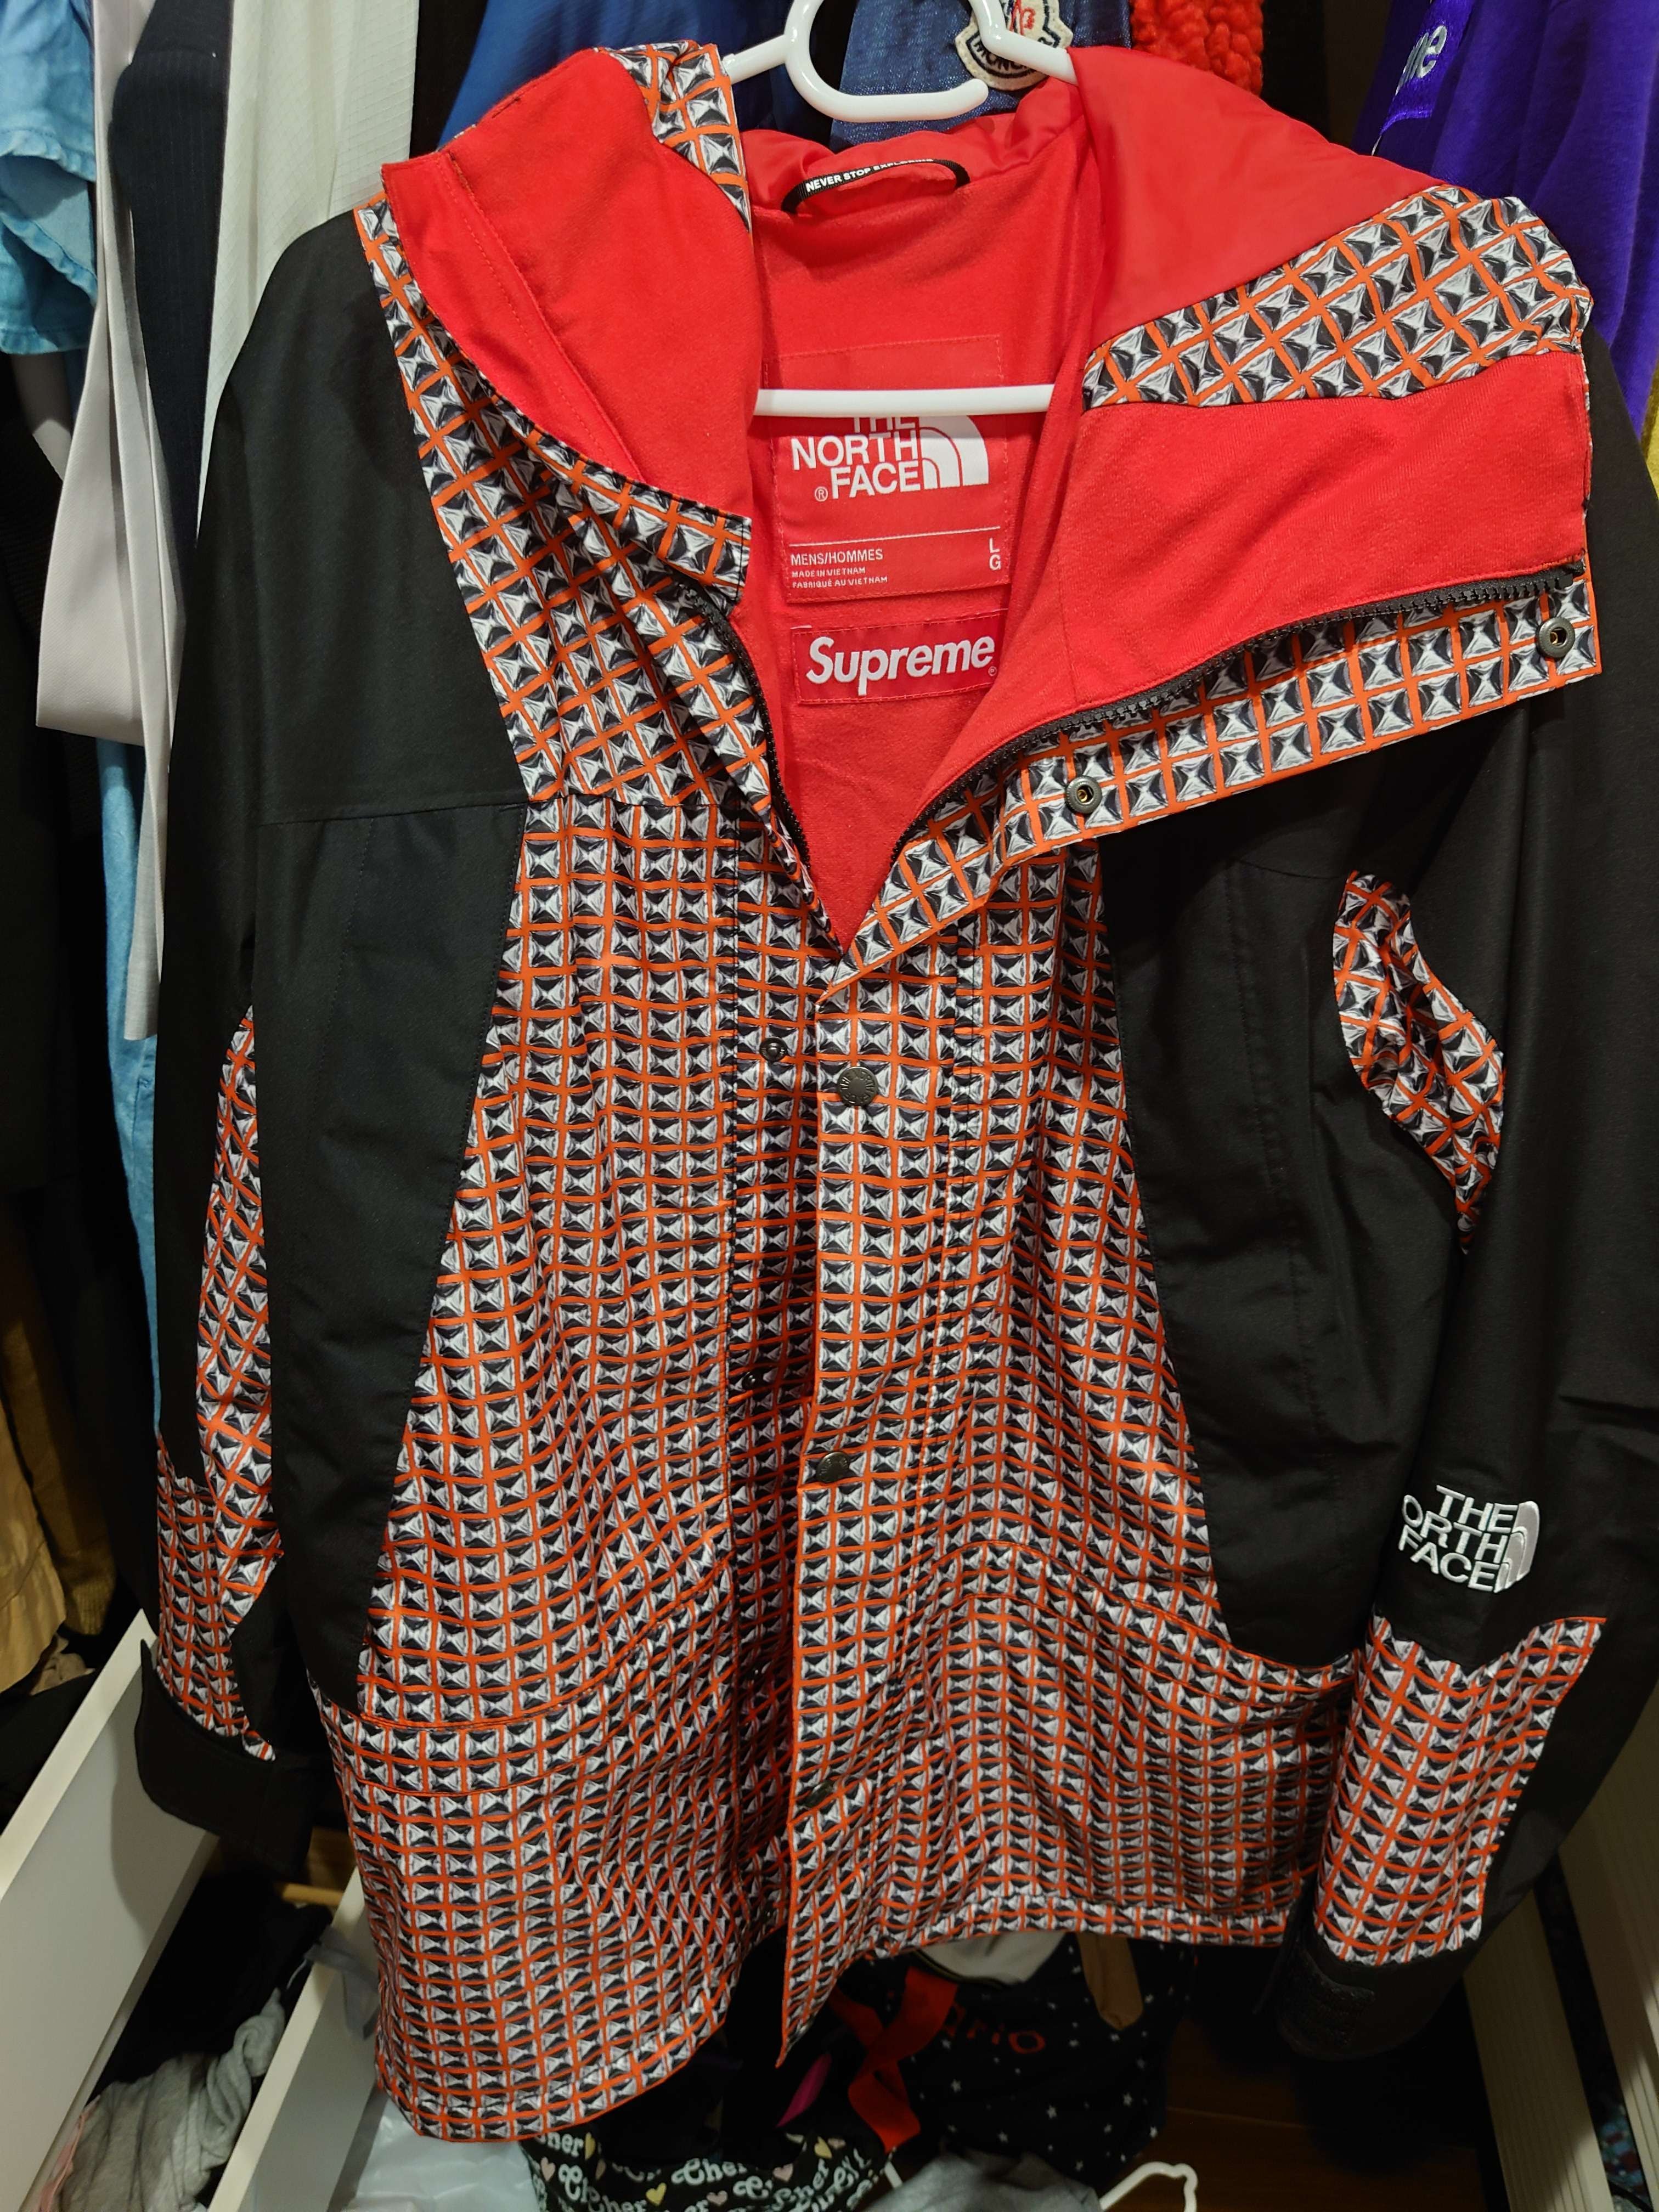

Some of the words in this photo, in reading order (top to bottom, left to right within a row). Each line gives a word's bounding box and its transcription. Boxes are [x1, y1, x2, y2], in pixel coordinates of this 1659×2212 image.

[805, 175, 843, 193] NEVER
[843, 167, 871, 180] STOP
[791, 430, 919, 471] NORTH
[830, 460, 921, 499] FACE
[791, 548, 883, 567] MENS/HOMMES
[989, 537, 1001, 554] L
[827, 567, 866, 576] VIETNAM
[989, 554, 1001, 571] G
[792, 579, 832, 589] FABRIQUÉ
[834, 579, 846, 587] AU
[848, 575, 888, 586] VIETNAM
[806, 636, 995, 696] Supreme
[1436, 1485, 1519, 1534] THE
[1402, 1494, 1509, 1564] ORTH
[1398, 1525, 1500, 1592] FACE
